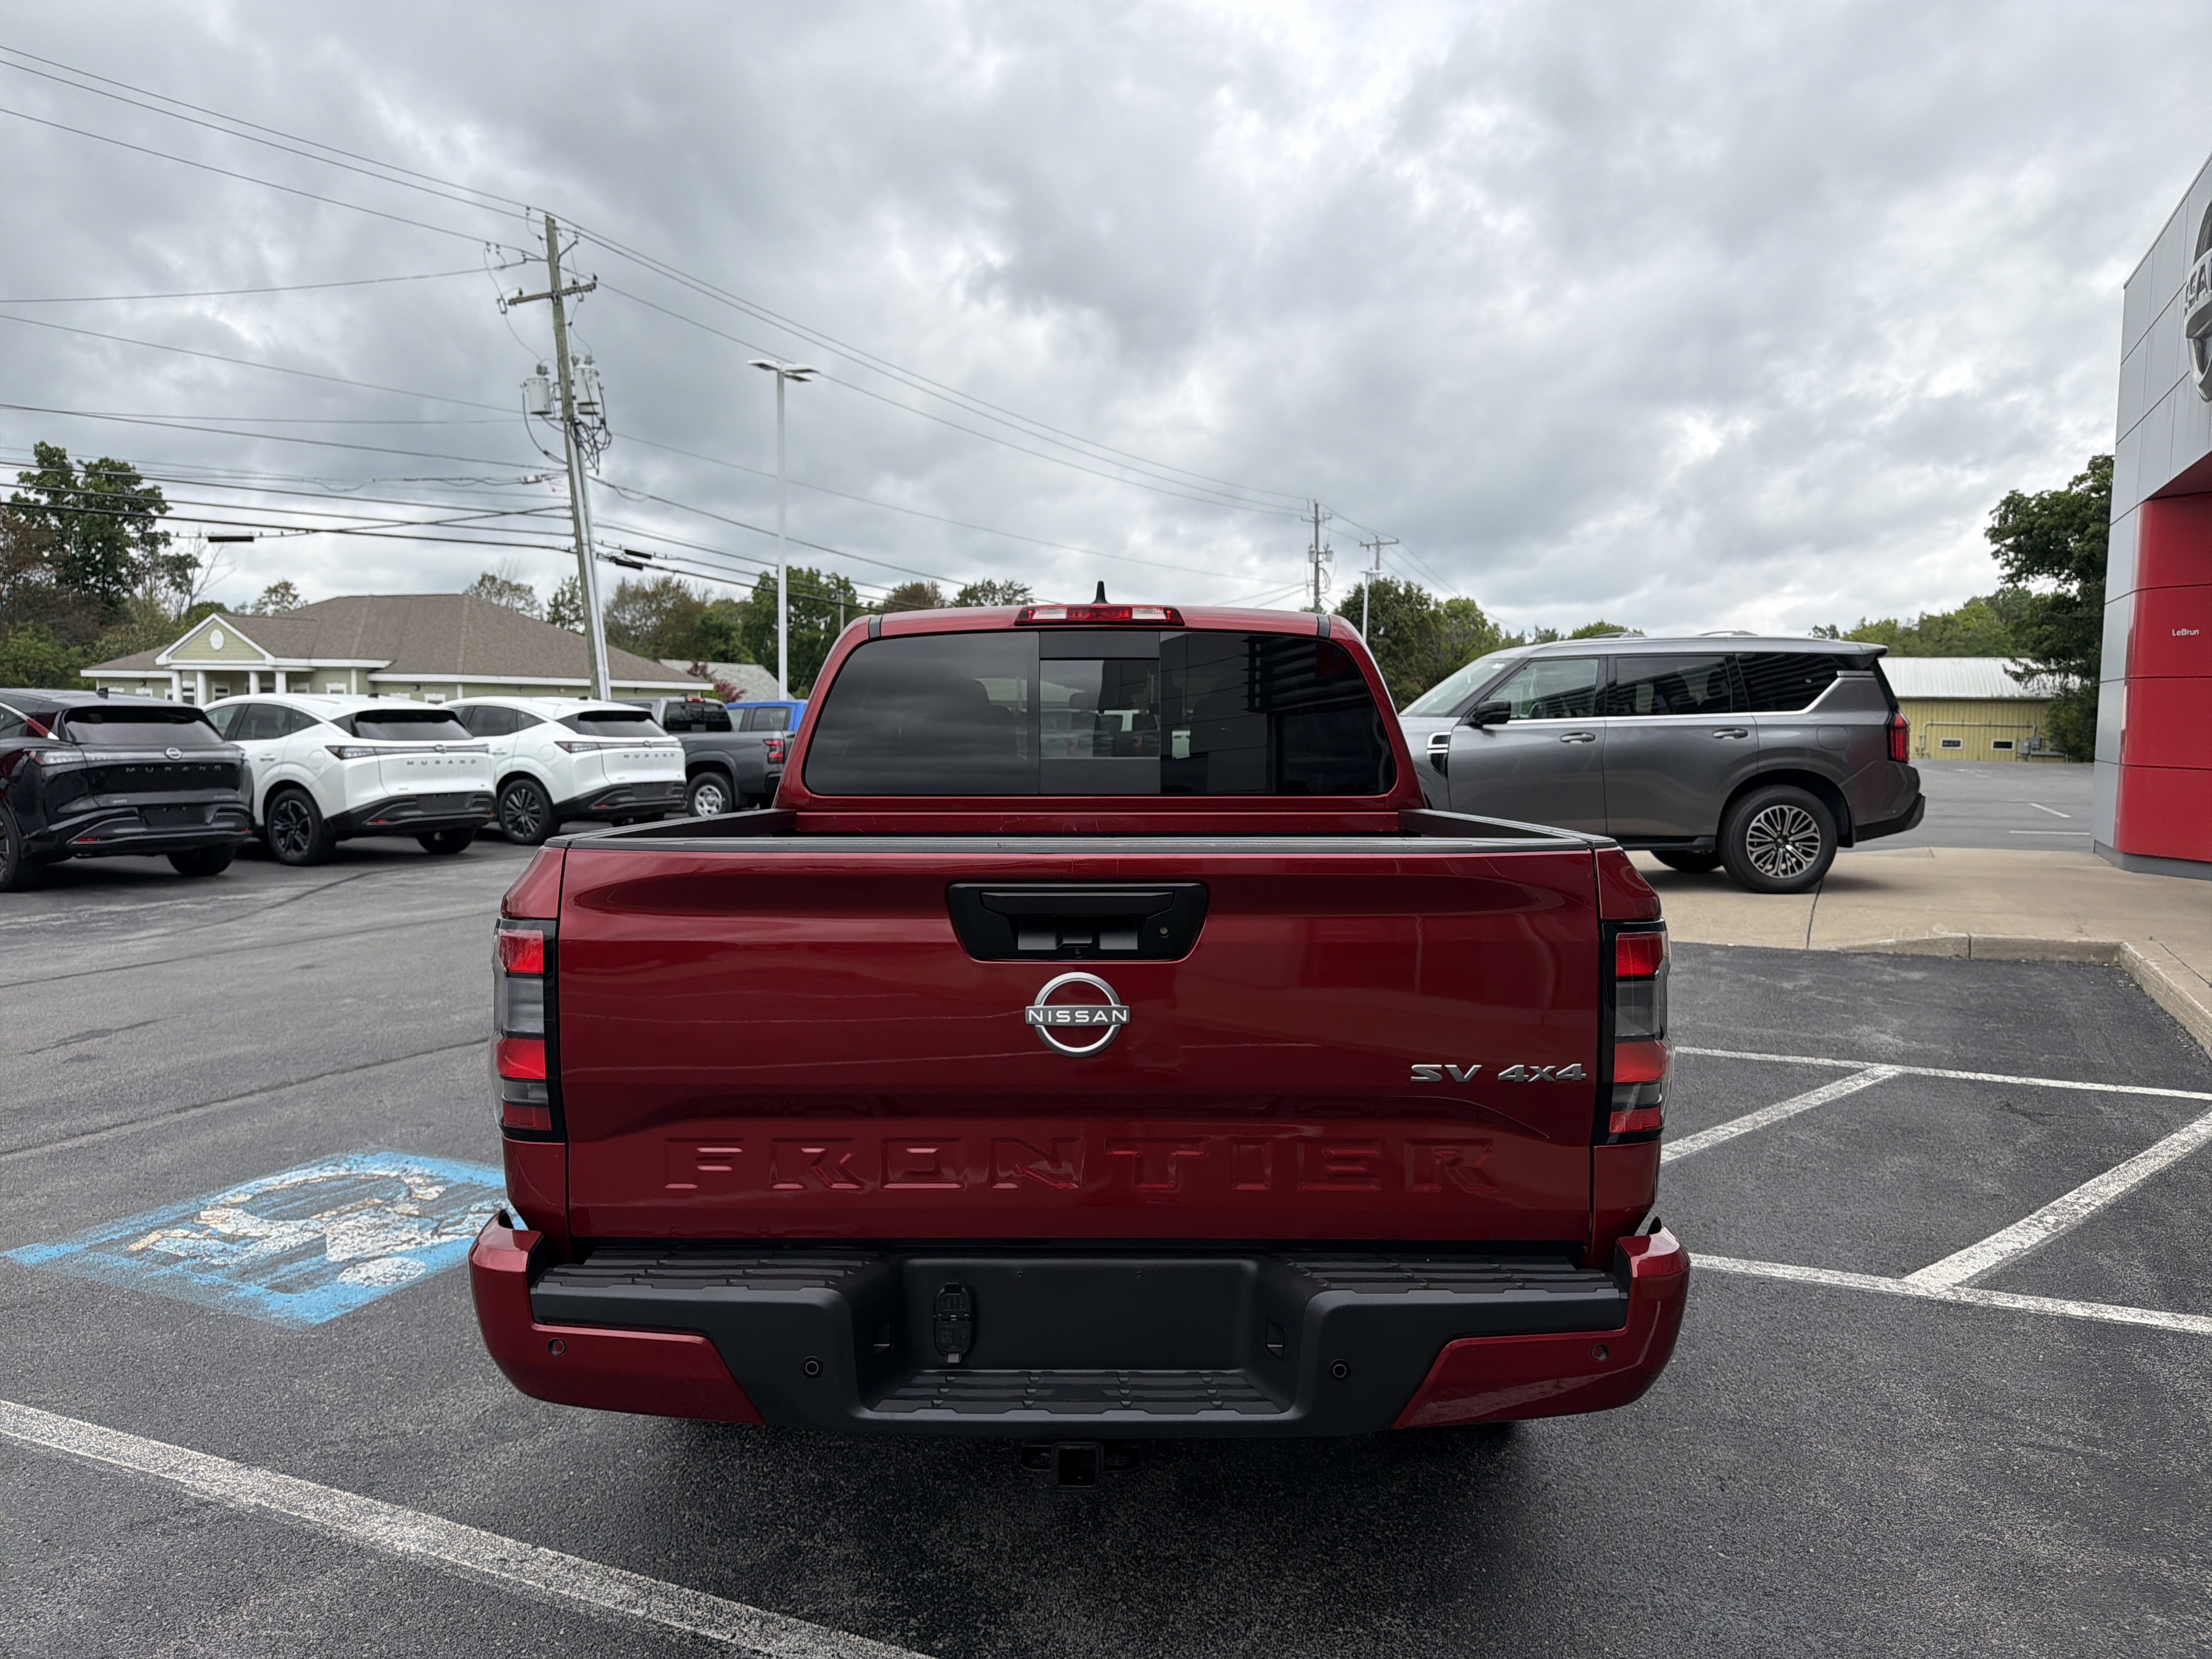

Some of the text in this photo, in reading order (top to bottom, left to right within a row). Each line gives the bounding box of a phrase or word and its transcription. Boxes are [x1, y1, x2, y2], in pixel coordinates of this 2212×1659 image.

[2172, 628, 2199, 636] LeBrun
[125, 764, 222, 773] MURANO
[1028, 1009, 1127, 1023] NISSAN
[1410, 1064, 1483, 1082] SV
[663, 1136, 1499, 1193] FRONTIER
